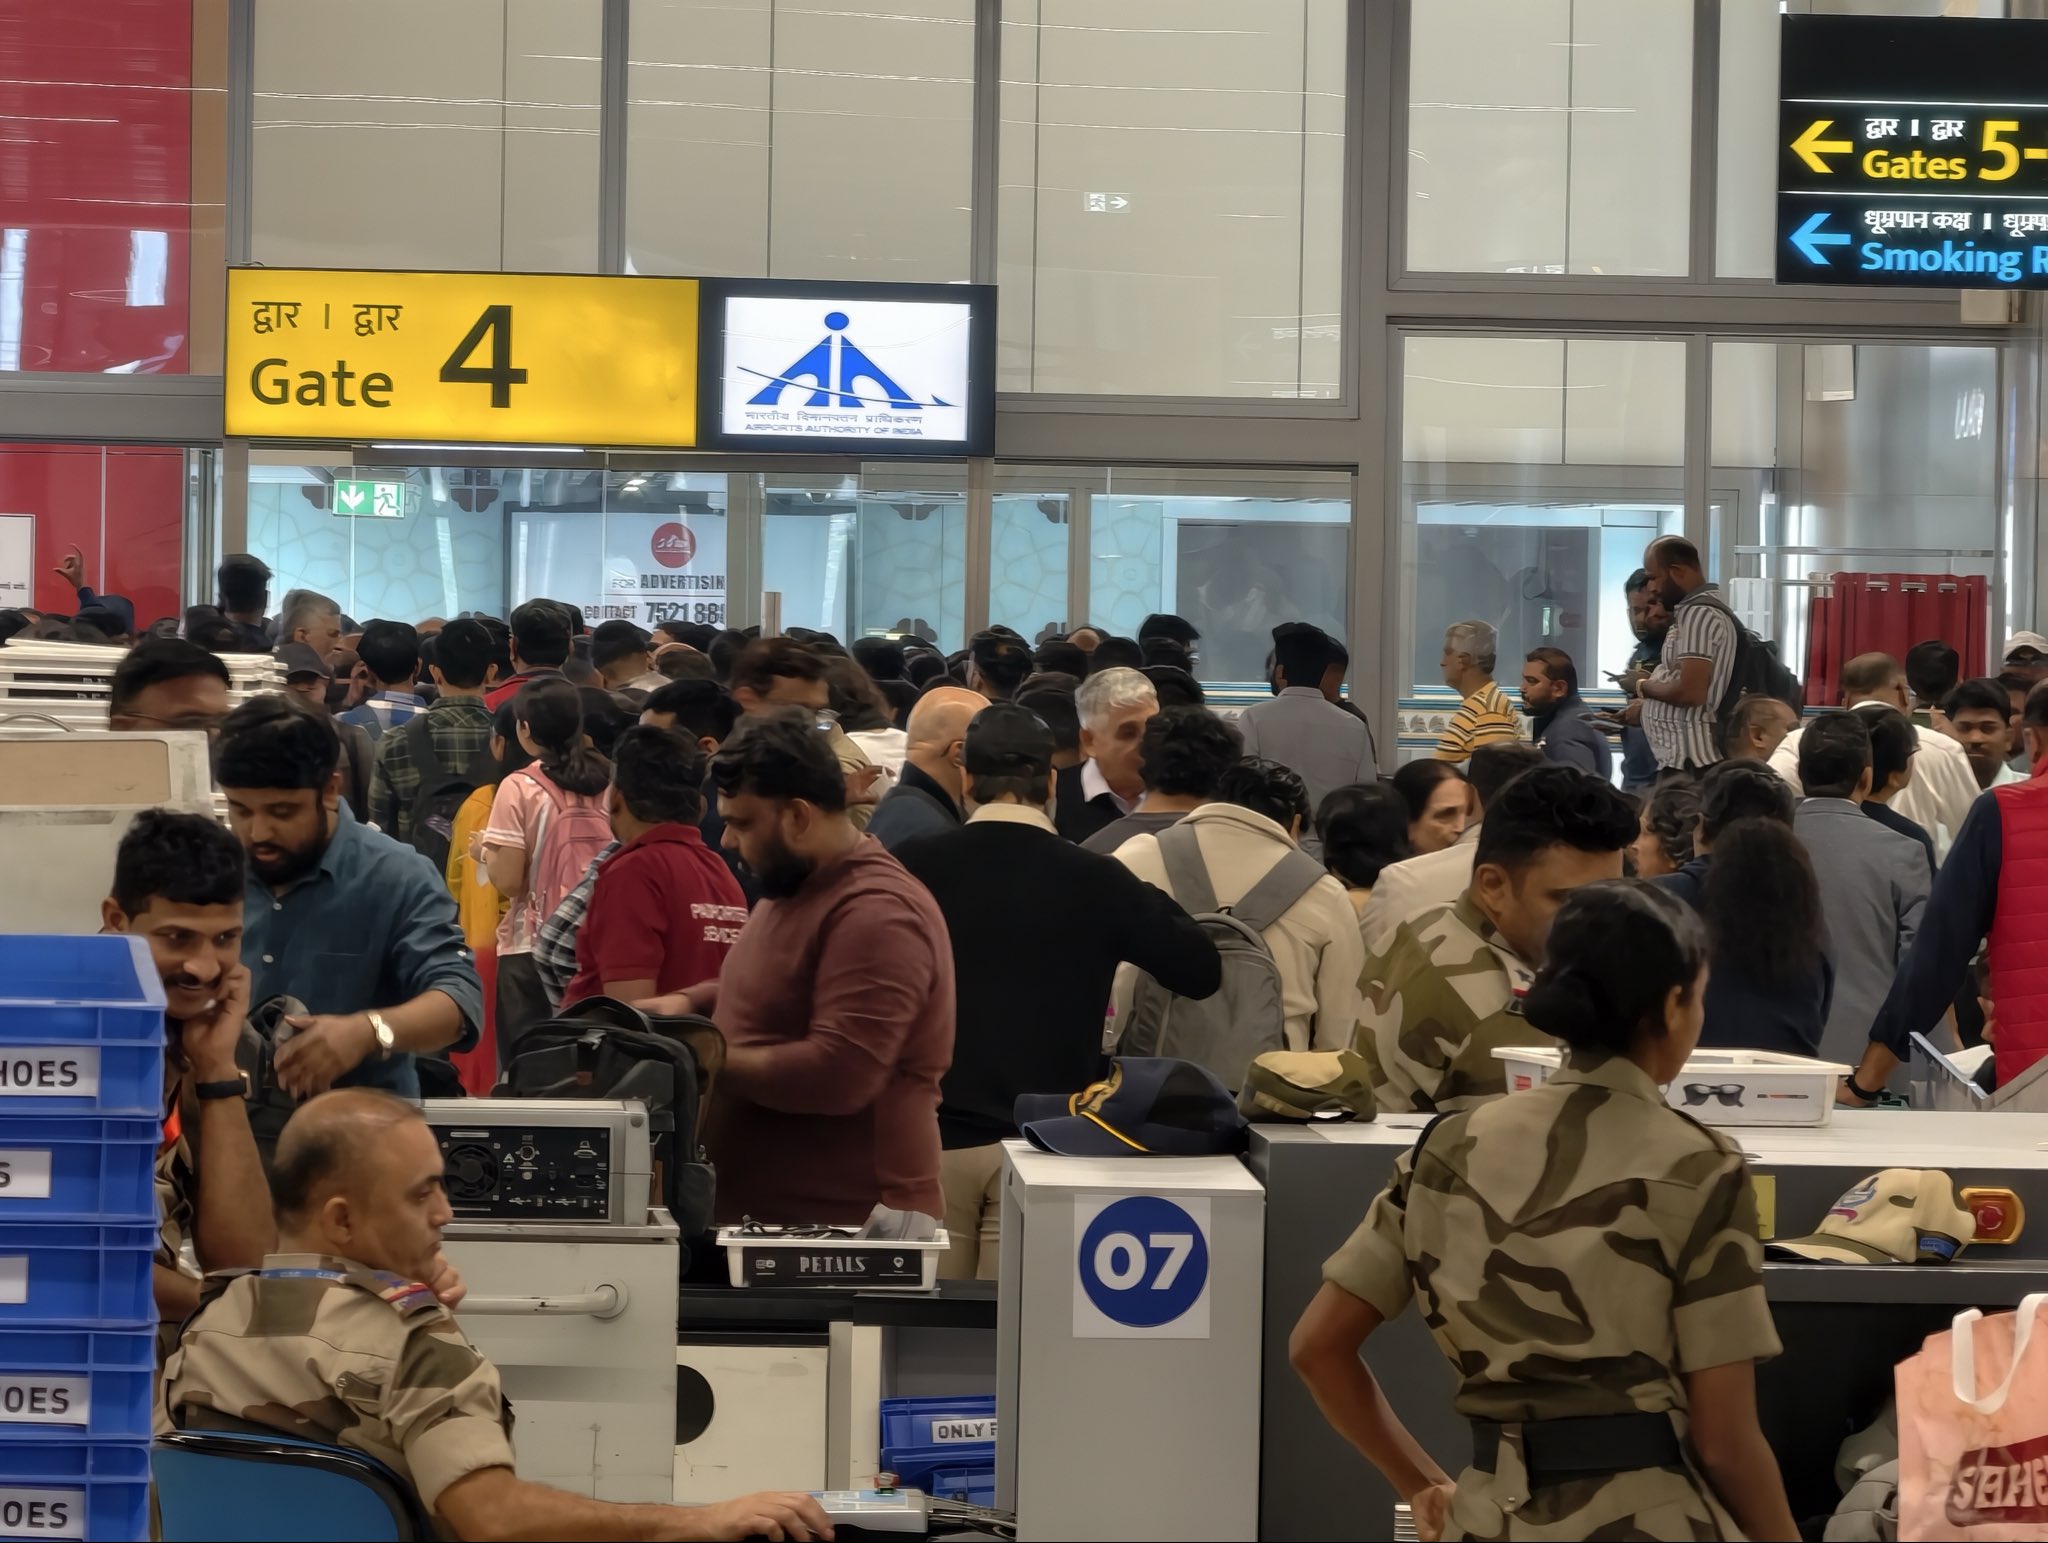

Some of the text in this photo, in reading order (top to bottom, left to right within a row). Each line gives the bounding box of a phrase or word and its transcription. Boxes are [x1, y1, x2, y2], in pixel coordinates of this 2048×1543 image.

[1864, 118, 1900, 139] द्वार
[1930, 119, 1966, 140] द्वार
[1862, 150, 1967, 180] Gates
[1932, 211, 1972, 231] कक्ष
[1861, 240, 2024, 282] Smoking
[251, 301, 302, 334] द्वार
[352, 304, 403, 336] द्वार
[251, 305, 528, 408] Gate 4
[800, 1257, 869, 1273] PETALS
[1093, 1231, 1194, 1290] 07
[938, 1422, 985, 1439] ONLY
